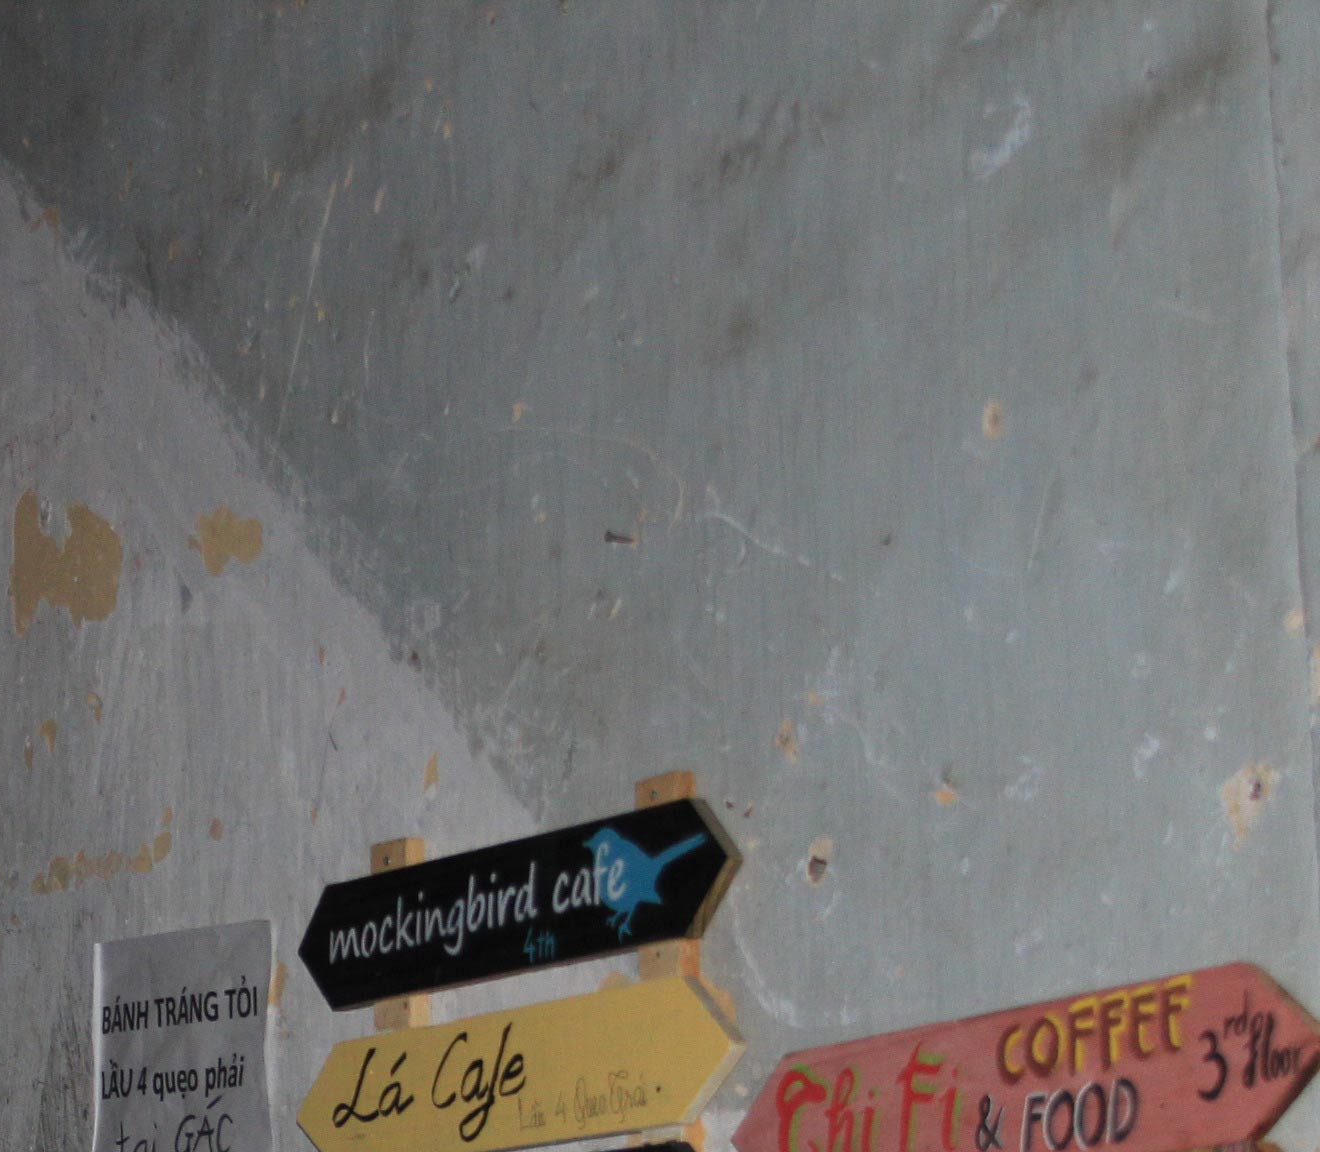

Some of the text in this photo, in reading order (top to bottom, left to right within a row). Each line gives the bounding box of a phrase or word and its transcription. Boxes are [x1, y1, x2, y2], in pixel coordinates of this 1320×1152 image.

[329, 843, 628, 964] mockingbird cafe
[523, 930, 556, 963] 4th
[102, 975, 257, 1034] BÁNH TRÁNG TỎI
[996, 973, 1194, 1084] COFFEE
[137, 1067, 146, 1094] 4
[975, 1094, 1005, 1152] &
